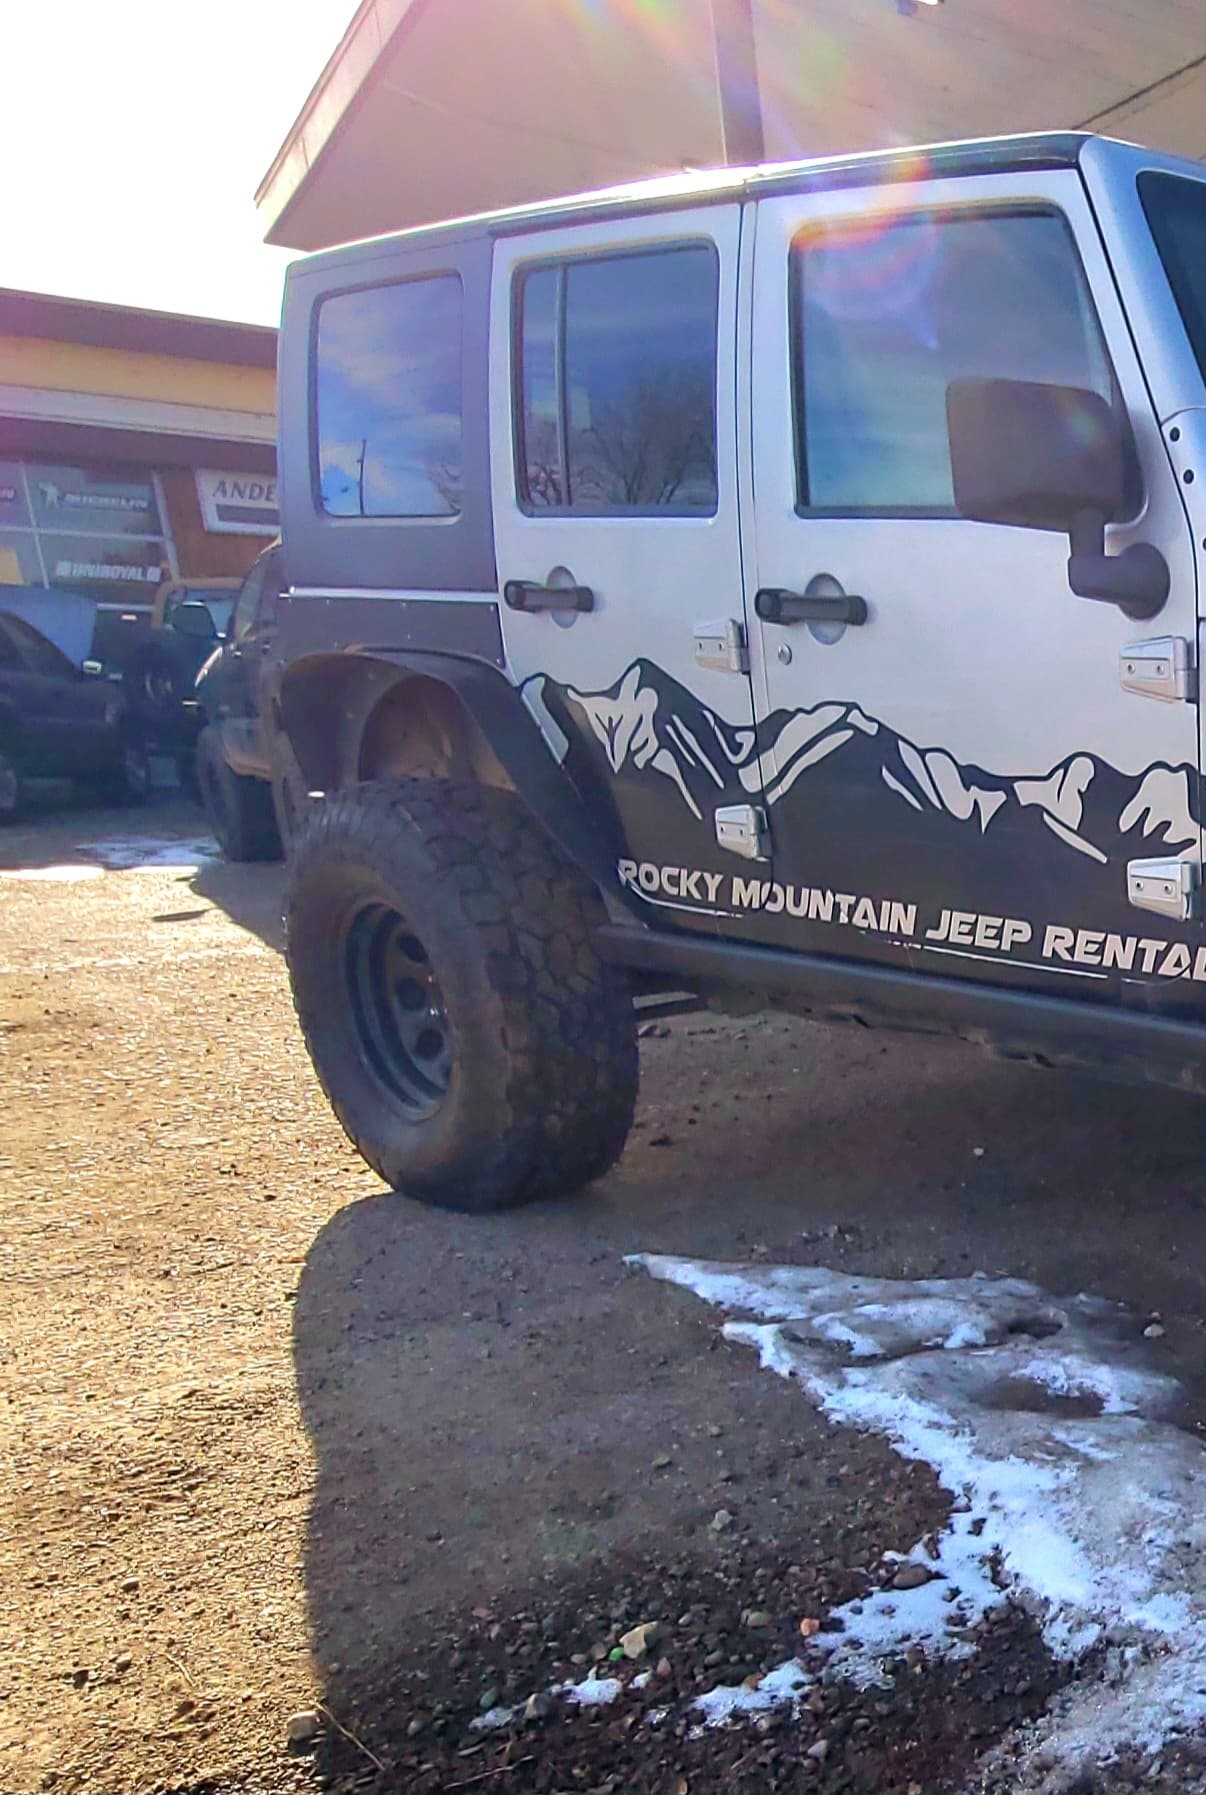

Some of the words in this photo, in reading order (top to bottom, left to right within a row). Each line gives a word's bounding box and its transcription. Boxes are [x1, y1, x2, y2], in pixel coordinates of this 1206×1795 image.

[618, 858, 723, 901] ROCKY
[731, 876, 917, 936] MOUNTAIN
[925, 909, 1032, 952] JEEP
